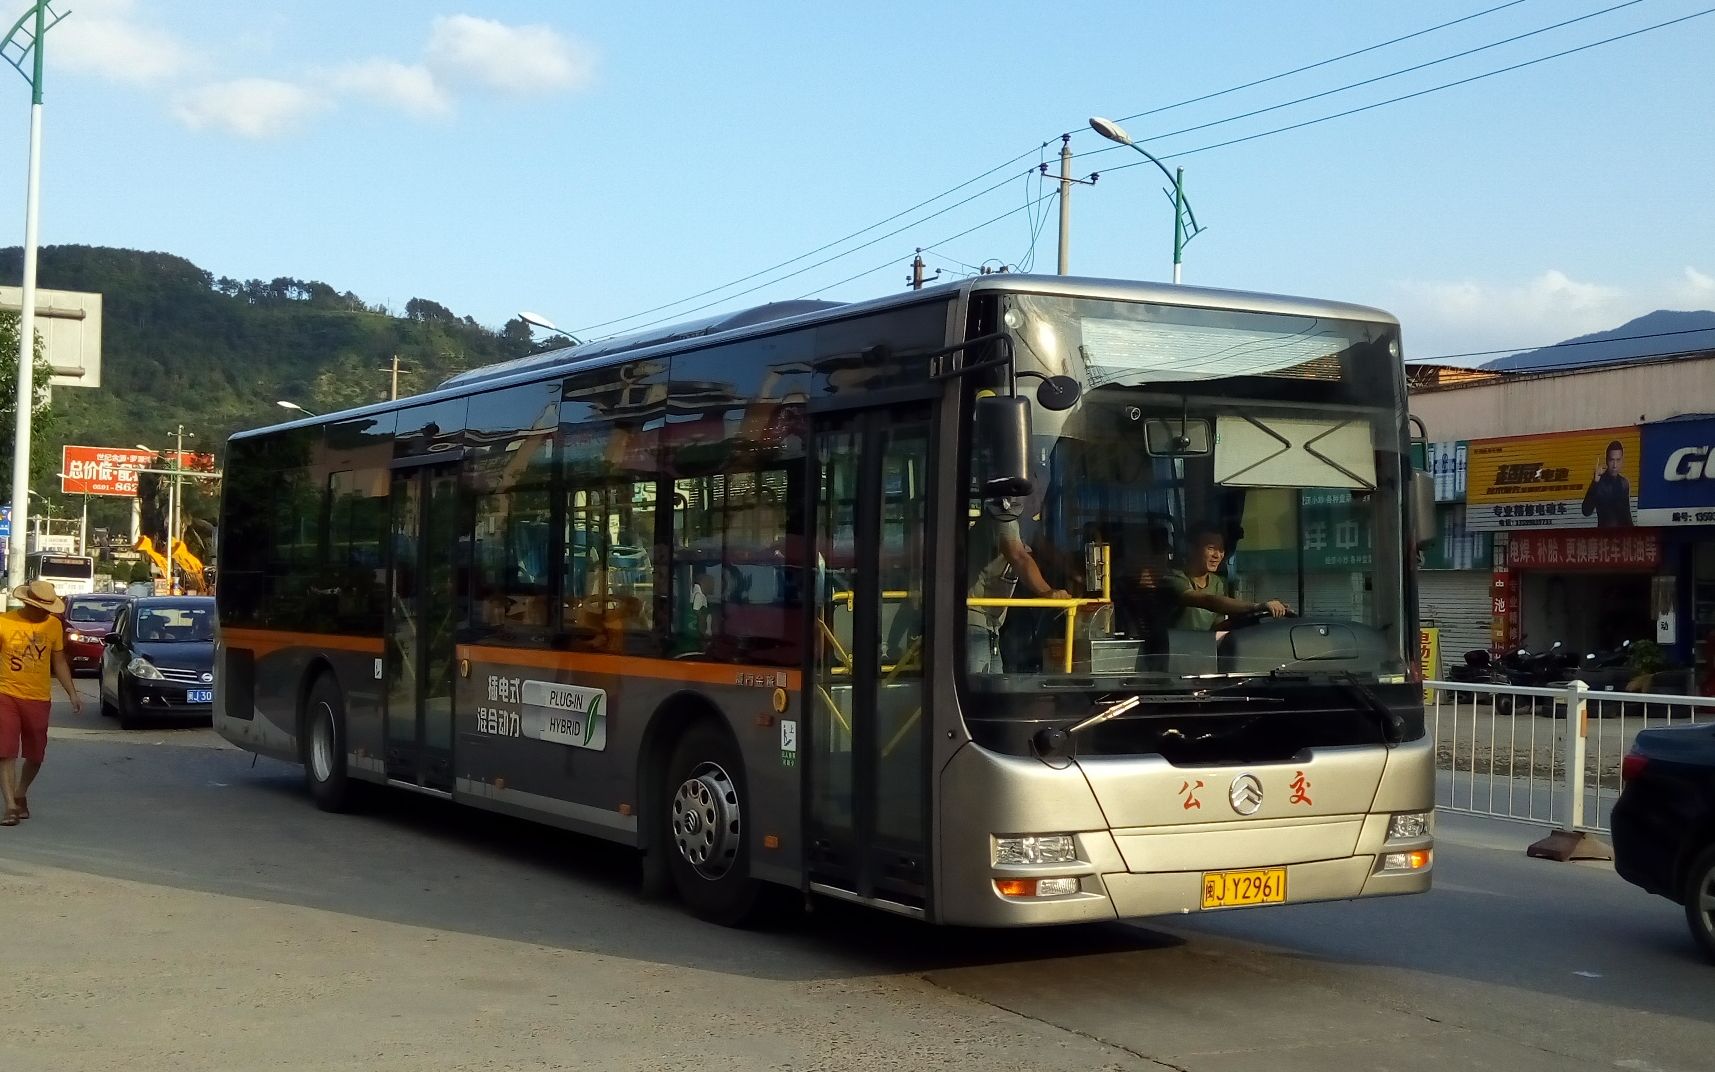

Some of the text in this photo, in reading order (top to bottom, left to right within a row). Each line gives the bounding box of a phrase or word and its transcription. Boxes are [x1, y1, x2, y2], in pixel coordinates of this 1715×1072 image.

[487, 675, 521, 704] 插电式
[550, 690, 583, 710] PLUG-IN
[477, 707, 521, 738] 混合动力
[550, 717, 581, 737] HYBRID
